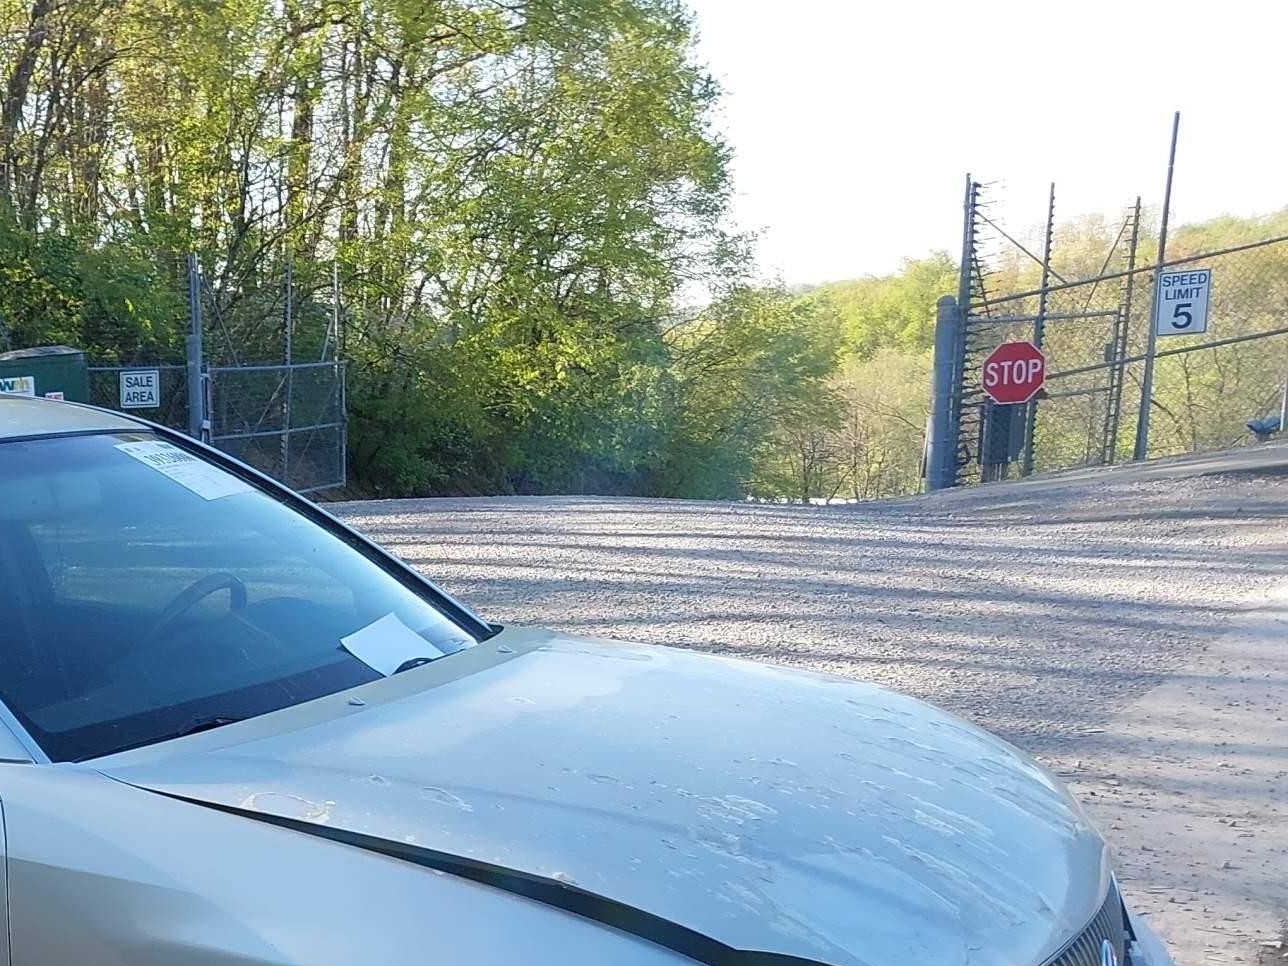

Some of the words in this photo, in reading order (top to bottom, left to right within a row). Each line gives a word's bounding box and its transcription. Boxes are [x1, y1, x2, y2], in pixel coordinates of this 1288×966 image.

[1162, 273, 1208, 287] SPEED
[1165, 287, 1203, 300] LIMIT
[1171, 302, 1193, 329] 5
[985, 358, 1042, 386] STOP
[125, 376, 153, 388] SALE
[125, 391, 154, 402] AREA
